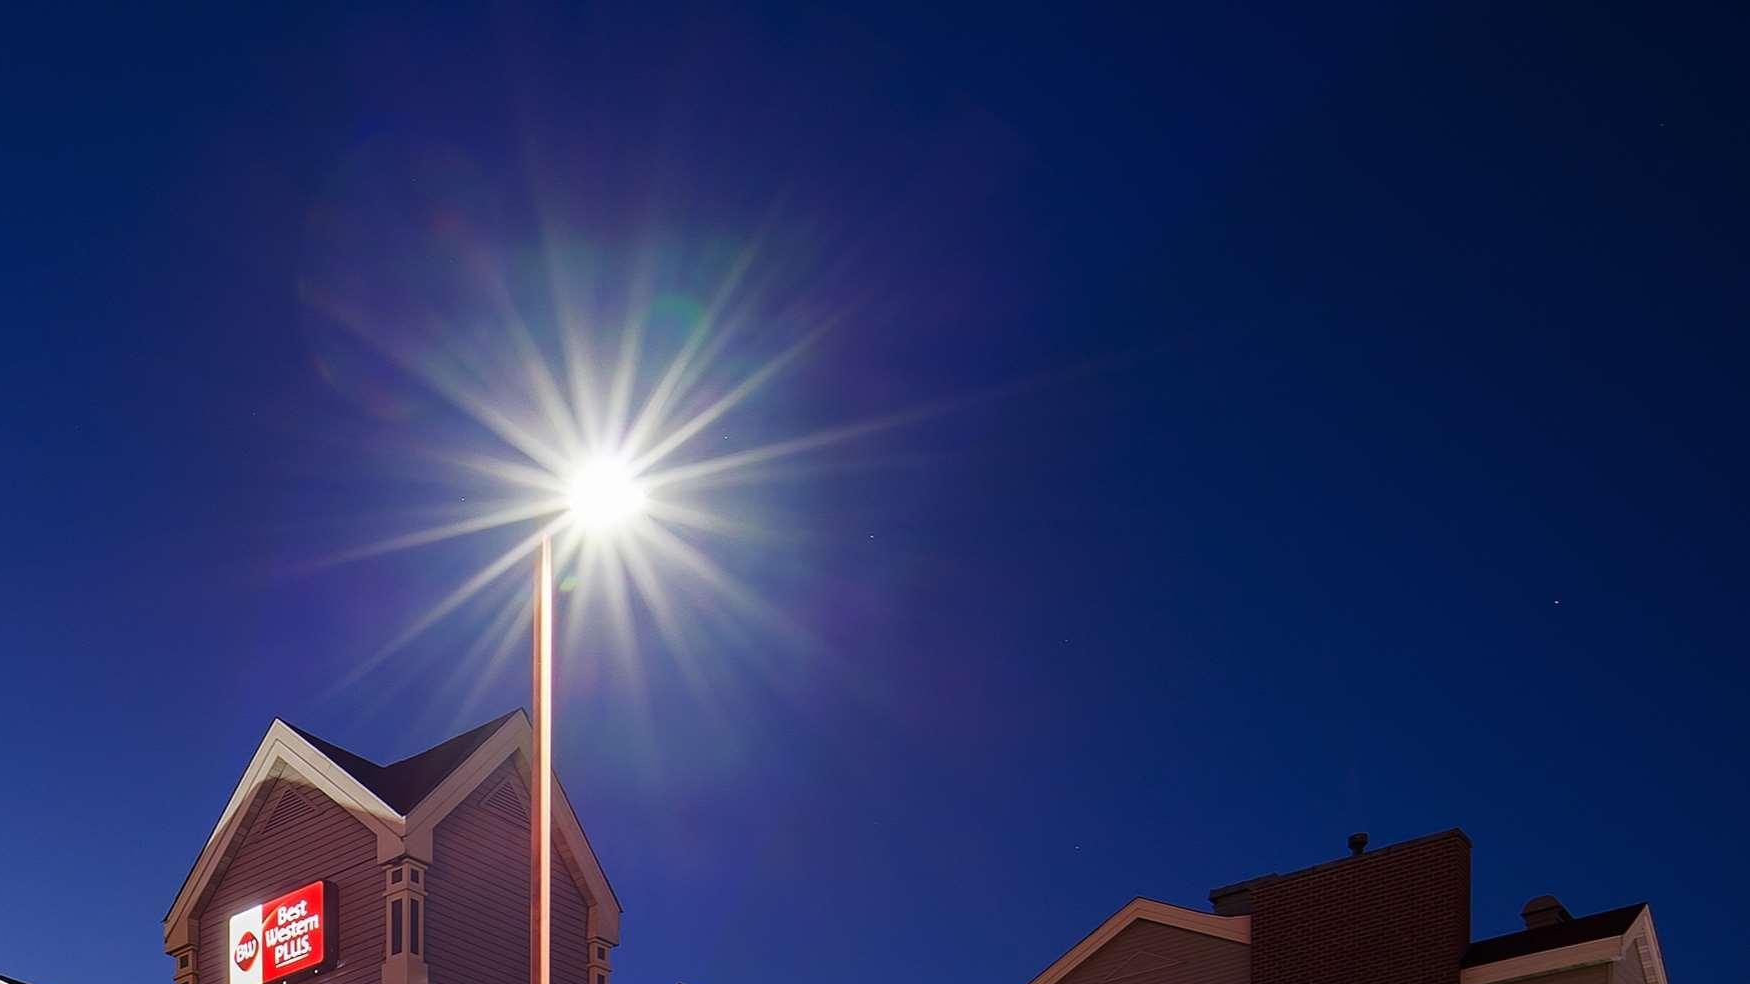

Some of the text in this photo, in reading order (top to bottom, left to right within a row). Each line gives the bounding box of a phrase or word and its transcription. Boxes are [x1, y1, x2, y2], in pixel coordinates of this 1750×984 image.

[277, 899, 307, 926] Best
[265, 914, 319, 947] Western
[235, 939, 257, 963] BW
